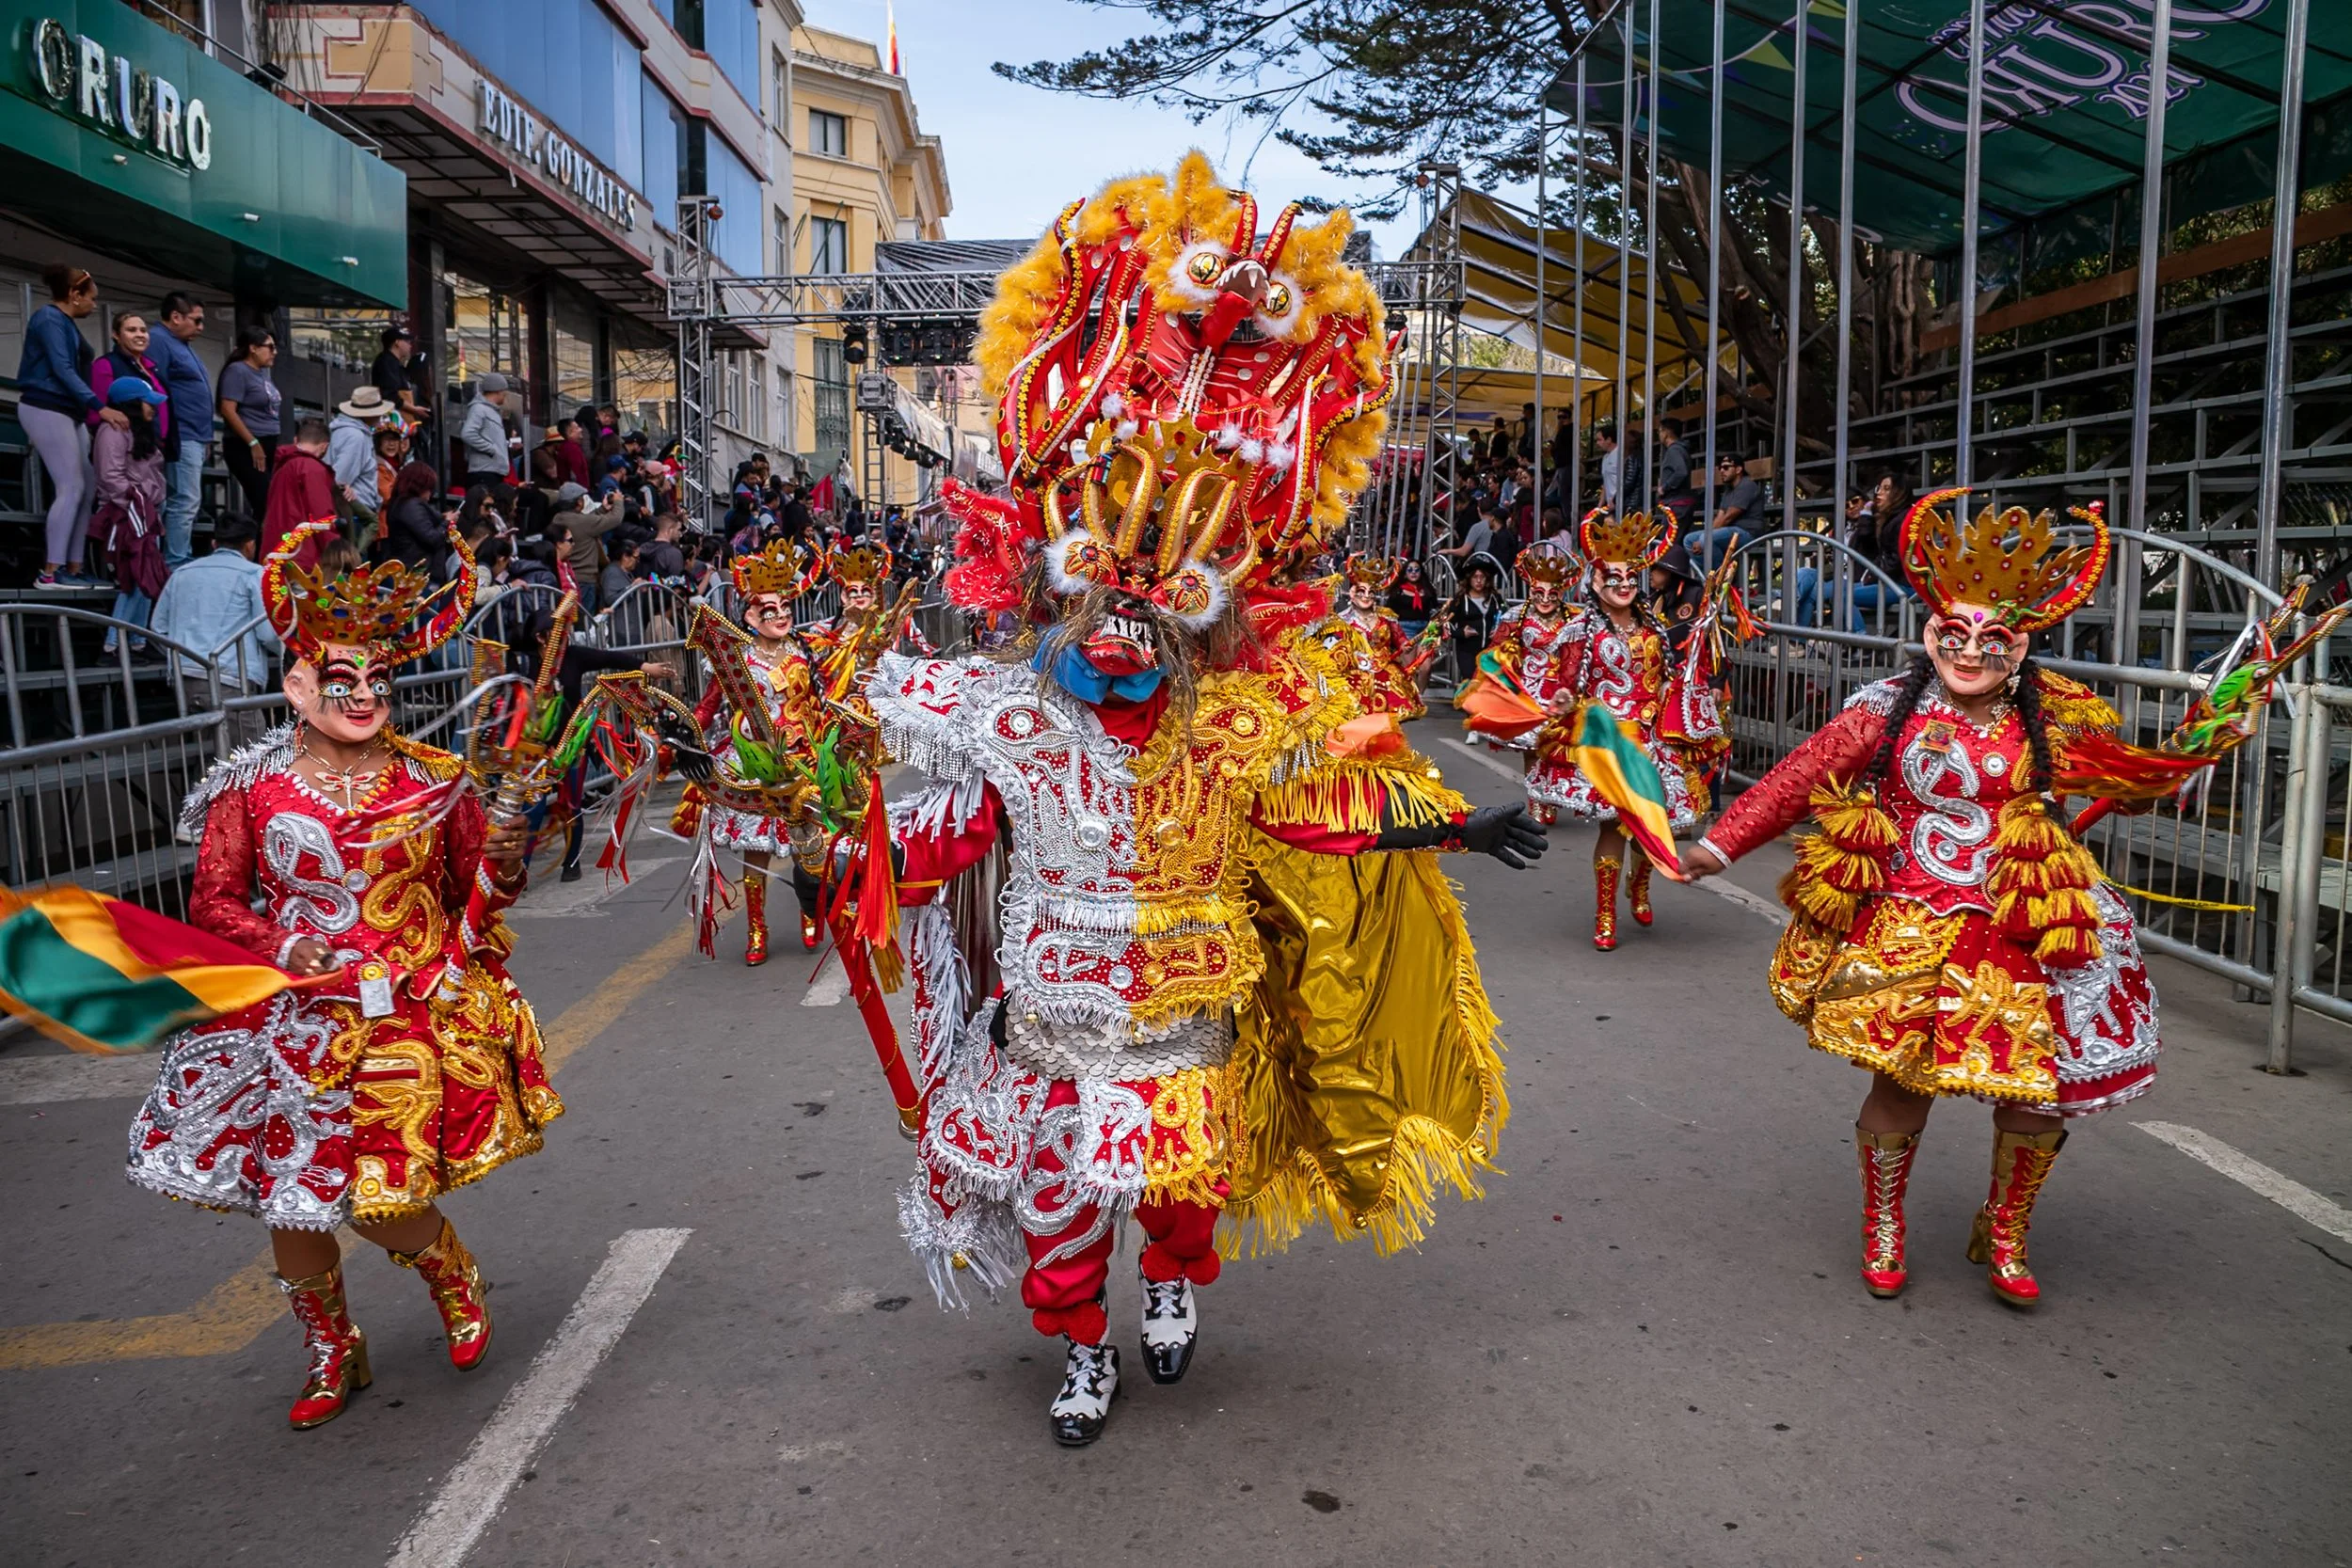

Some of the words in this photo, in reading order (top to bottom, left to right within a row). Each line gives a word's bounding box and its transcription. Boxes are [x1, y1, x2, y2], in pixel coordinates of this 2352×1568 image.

[32, 17, 212, 171] ORURO
[482, 80, 541, 165] EDIF.
[546, 130, 637, 232] GONZALES
